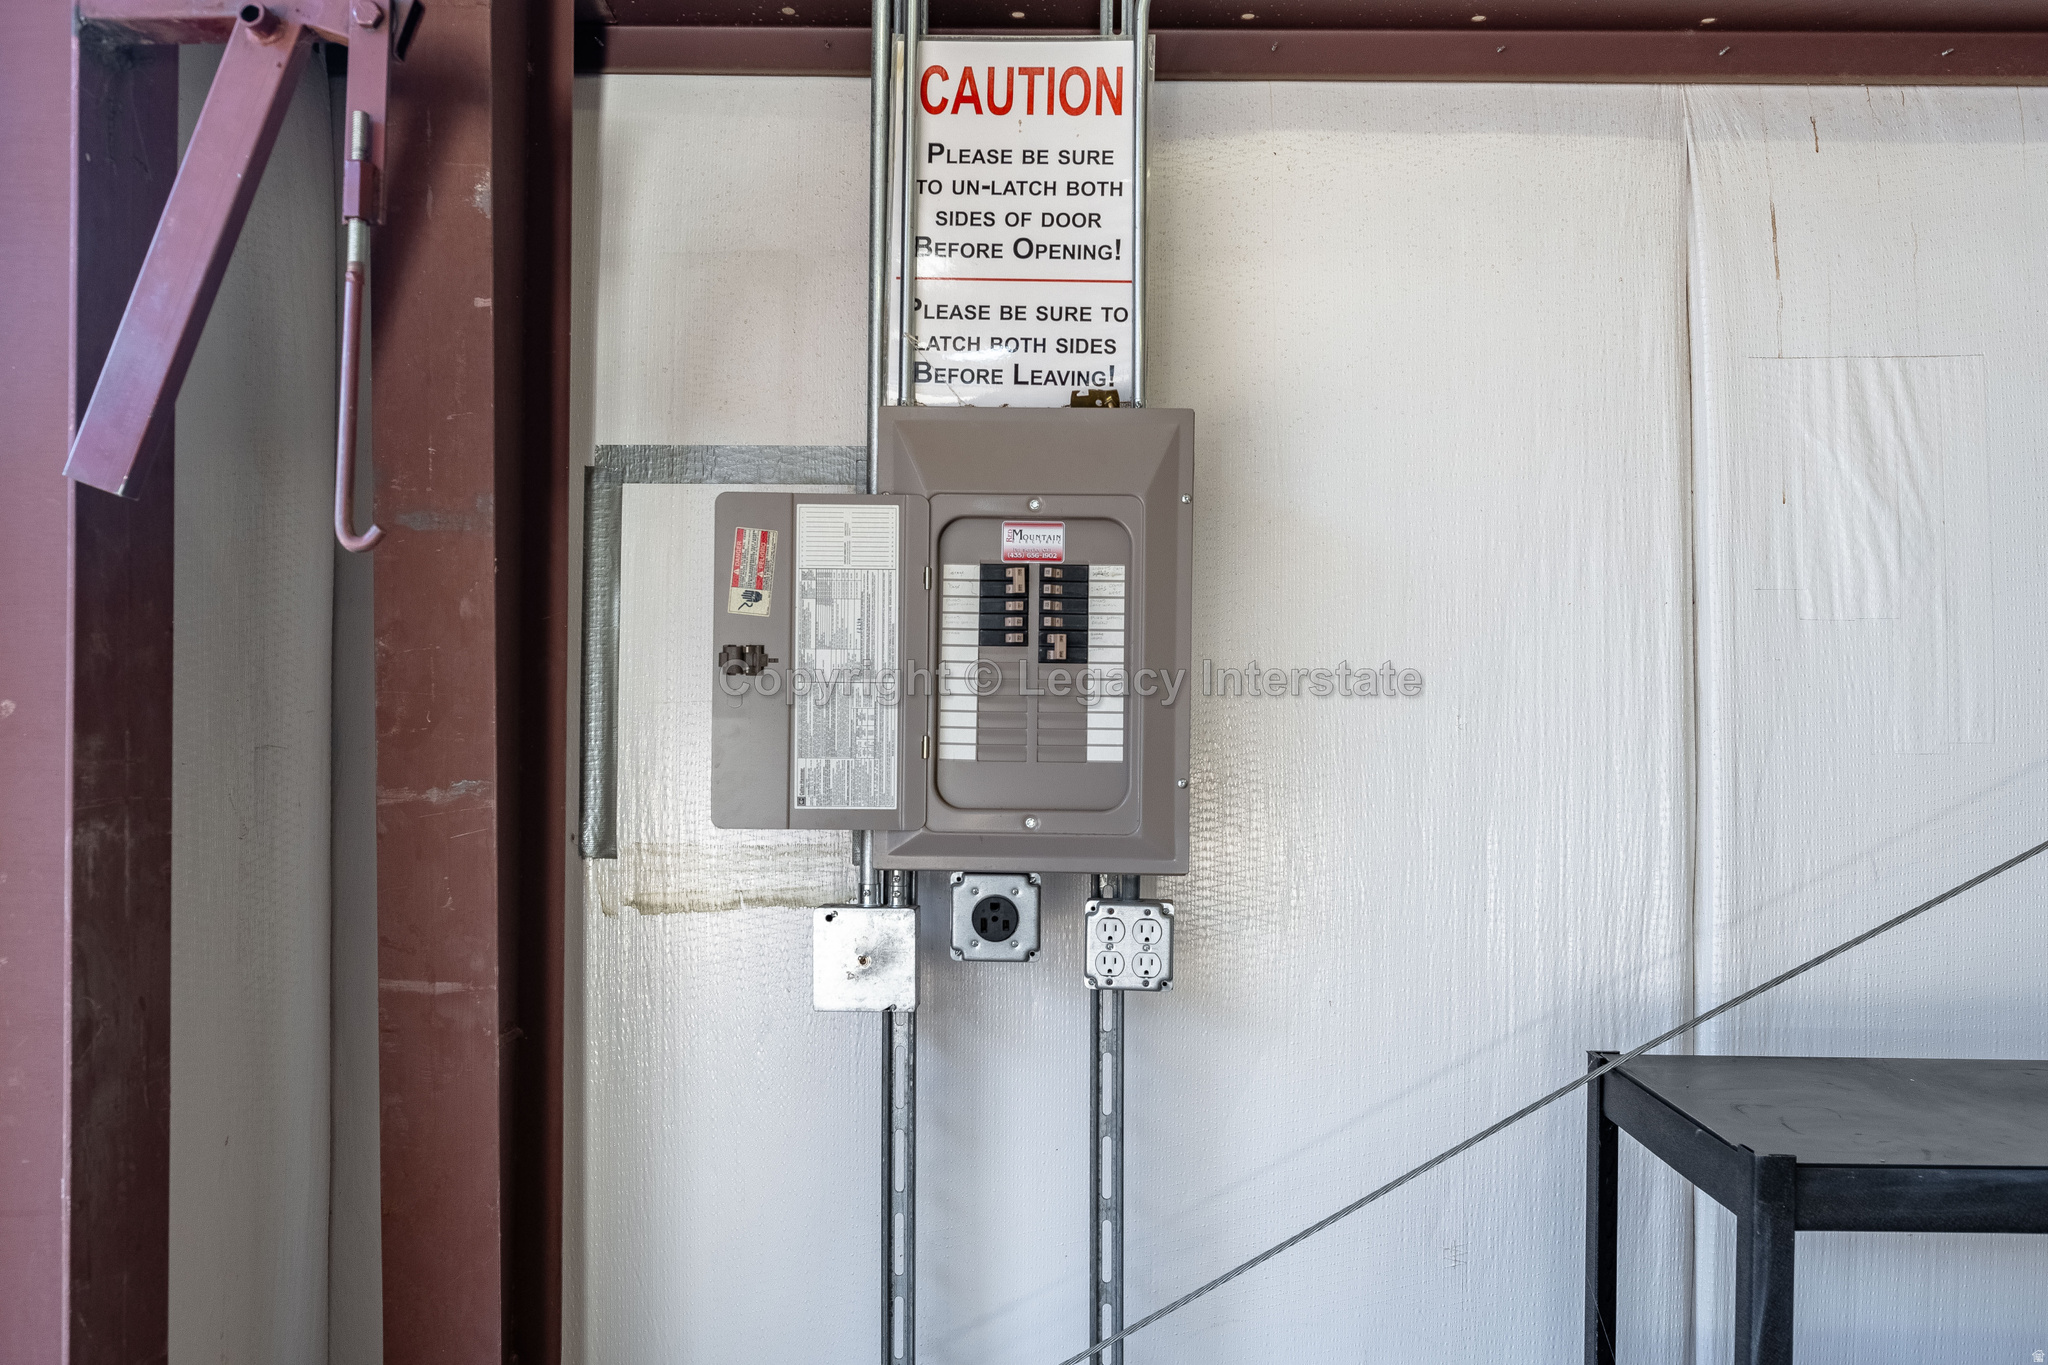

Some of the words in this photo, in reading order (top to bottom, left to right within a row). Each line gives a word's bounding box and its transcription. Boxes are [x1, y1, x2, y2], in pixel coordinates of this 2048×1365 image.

[920, 65, 1123, 116] CAUTION
[928, 143, 1013, 165] PLEASE
[1022, 150, 1049, 165] BE
[1058, 150, 1114, 165] SURE
[916, 179, 943, 195] TO
[952, 180, 1057, 196] UN-LATCH
[1066, 181, 1123, 197] BOTH
[935, 211, 996, 227] SIDES
[1004, 212, 1032, 227] OF
[1041, 213, 1102, 228] DOOR
[915, 236, 1003, 259] BEFORE
[1012, 237, 1121, 261] OPENING!
[1000, 305, 1027, 321] BE
[1035, 306, 1092, 322] SURE
[1100, 307, 1129, 323] TO
[990, 336, 1046, 354] BOTH
[1055, 338, 1117, 355] SIDES
[914, 361, 1003, 386] BEFORE
[1013, 363, 1116, 388] LEAVING!
[1012, 529, 1061, 541] MOUNTAIN
